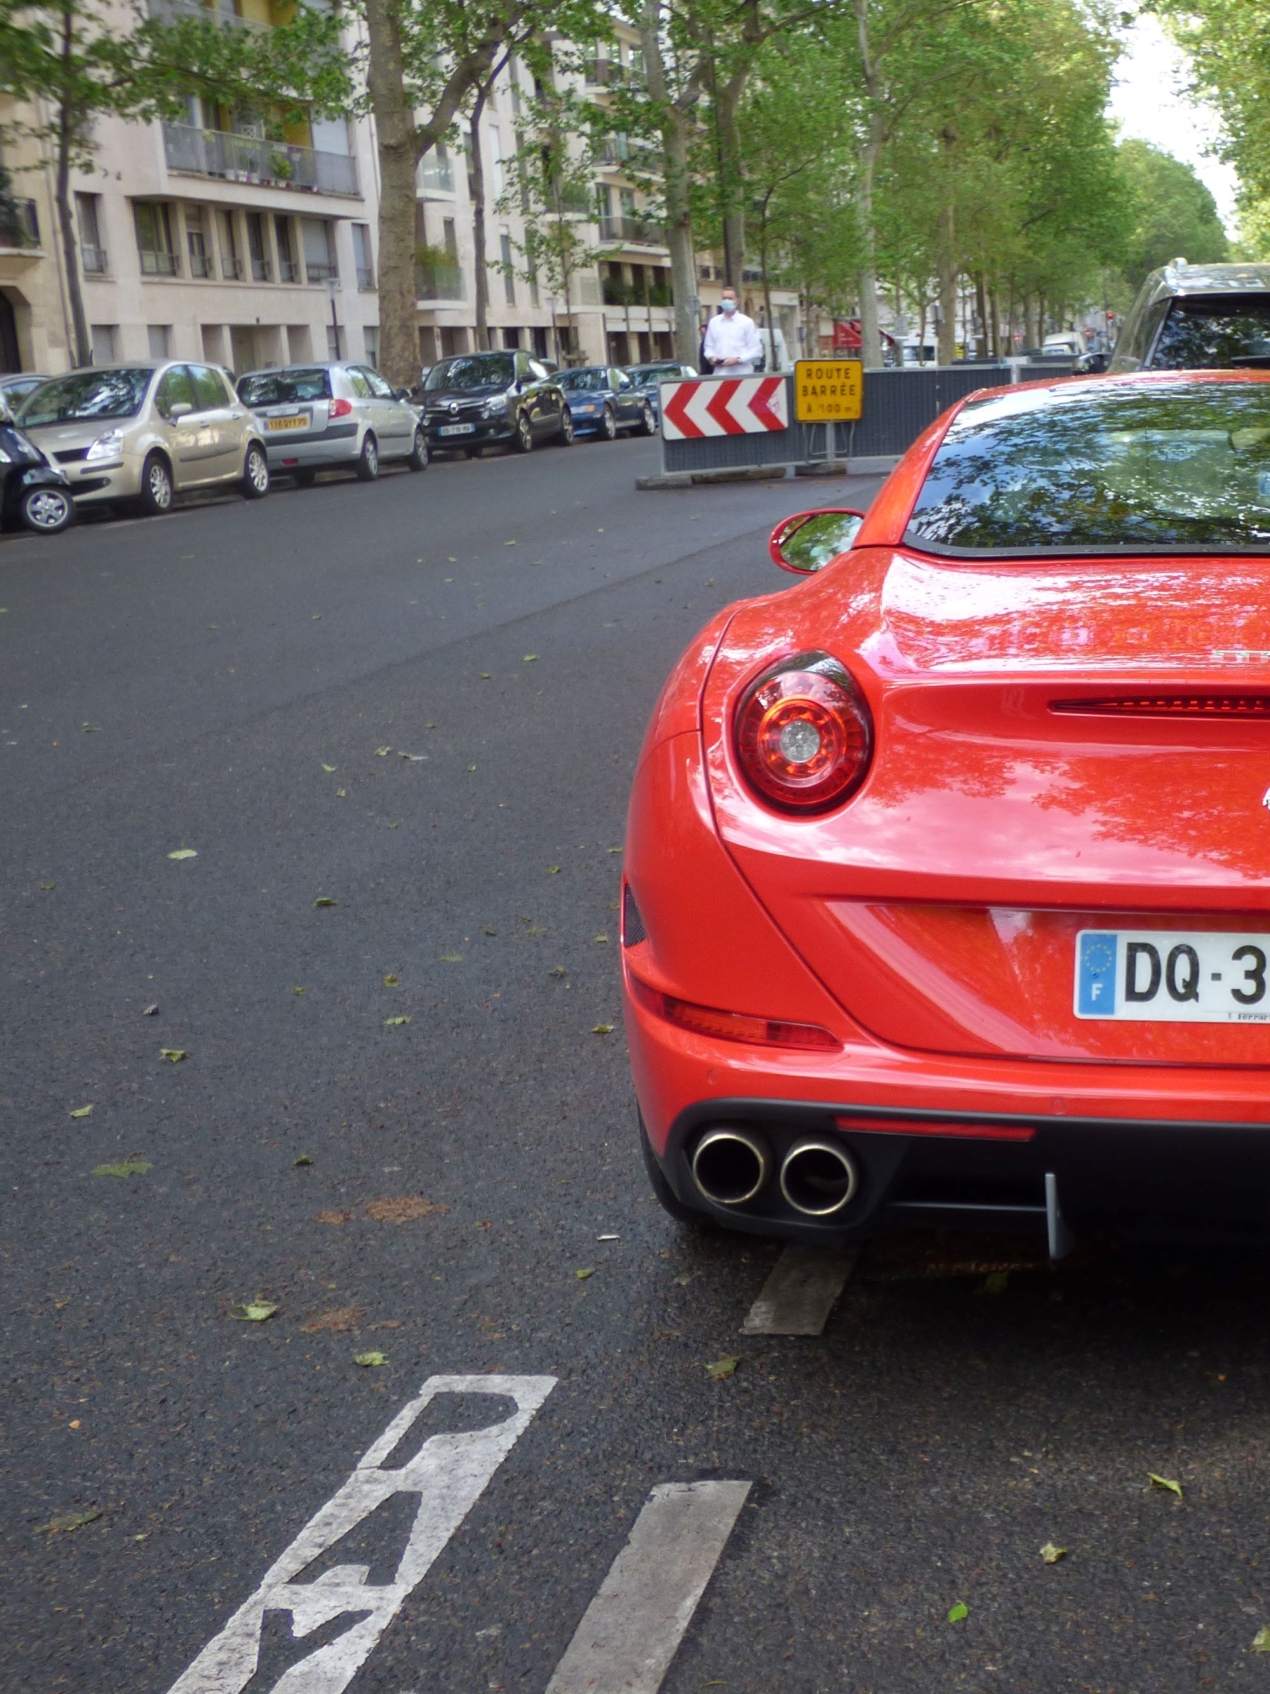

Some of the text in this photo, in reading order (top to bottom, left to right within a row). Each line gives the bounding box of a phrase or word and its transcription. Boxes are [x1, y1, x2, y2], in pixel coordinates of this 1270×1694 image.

[806, 368, 851, 380] ROUTE
[802, 382, 856, 397] BARRÉE
[1091, 983, 1103, 1001] F
